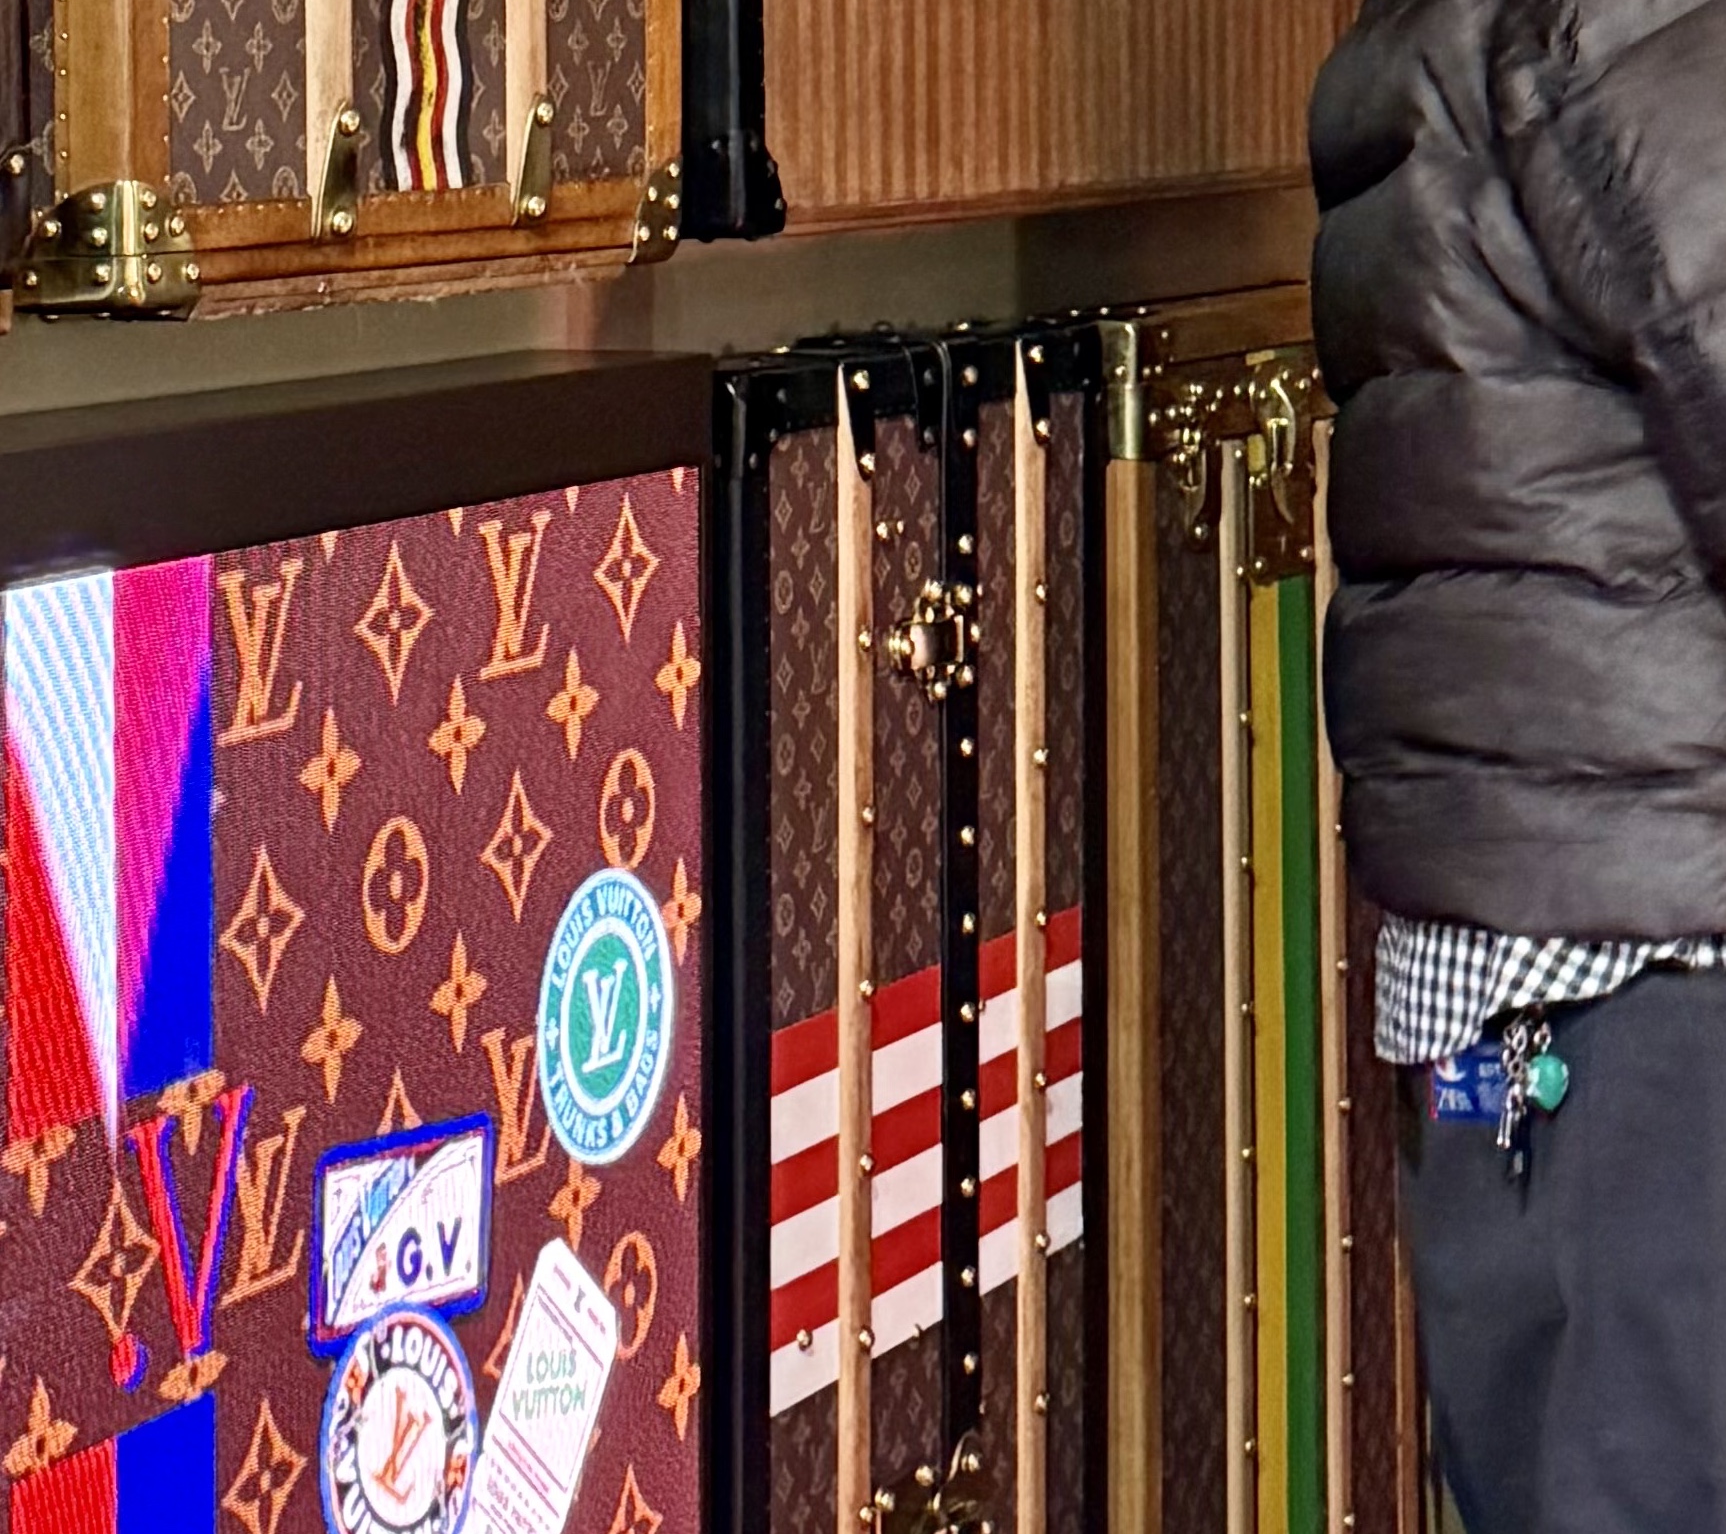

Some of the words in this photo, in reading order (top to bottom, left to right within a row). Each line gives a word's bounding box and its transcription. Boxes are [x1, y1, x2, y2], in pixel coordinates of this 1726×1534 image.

[552, 899, 594, 990] LOUIS
[595, 880, 658, 961] VUITTON
[582, 958, 629, 1074] LV
[549, 1061, 608, 1149] TRUNKS
[626, 1028, 660, 1113] BAGS
[391, 1324, 459, 1409] LOUIS
[512, 1382, 587, 1422] VUITTON
[526, 1347, 577, 1385] LOUIS
